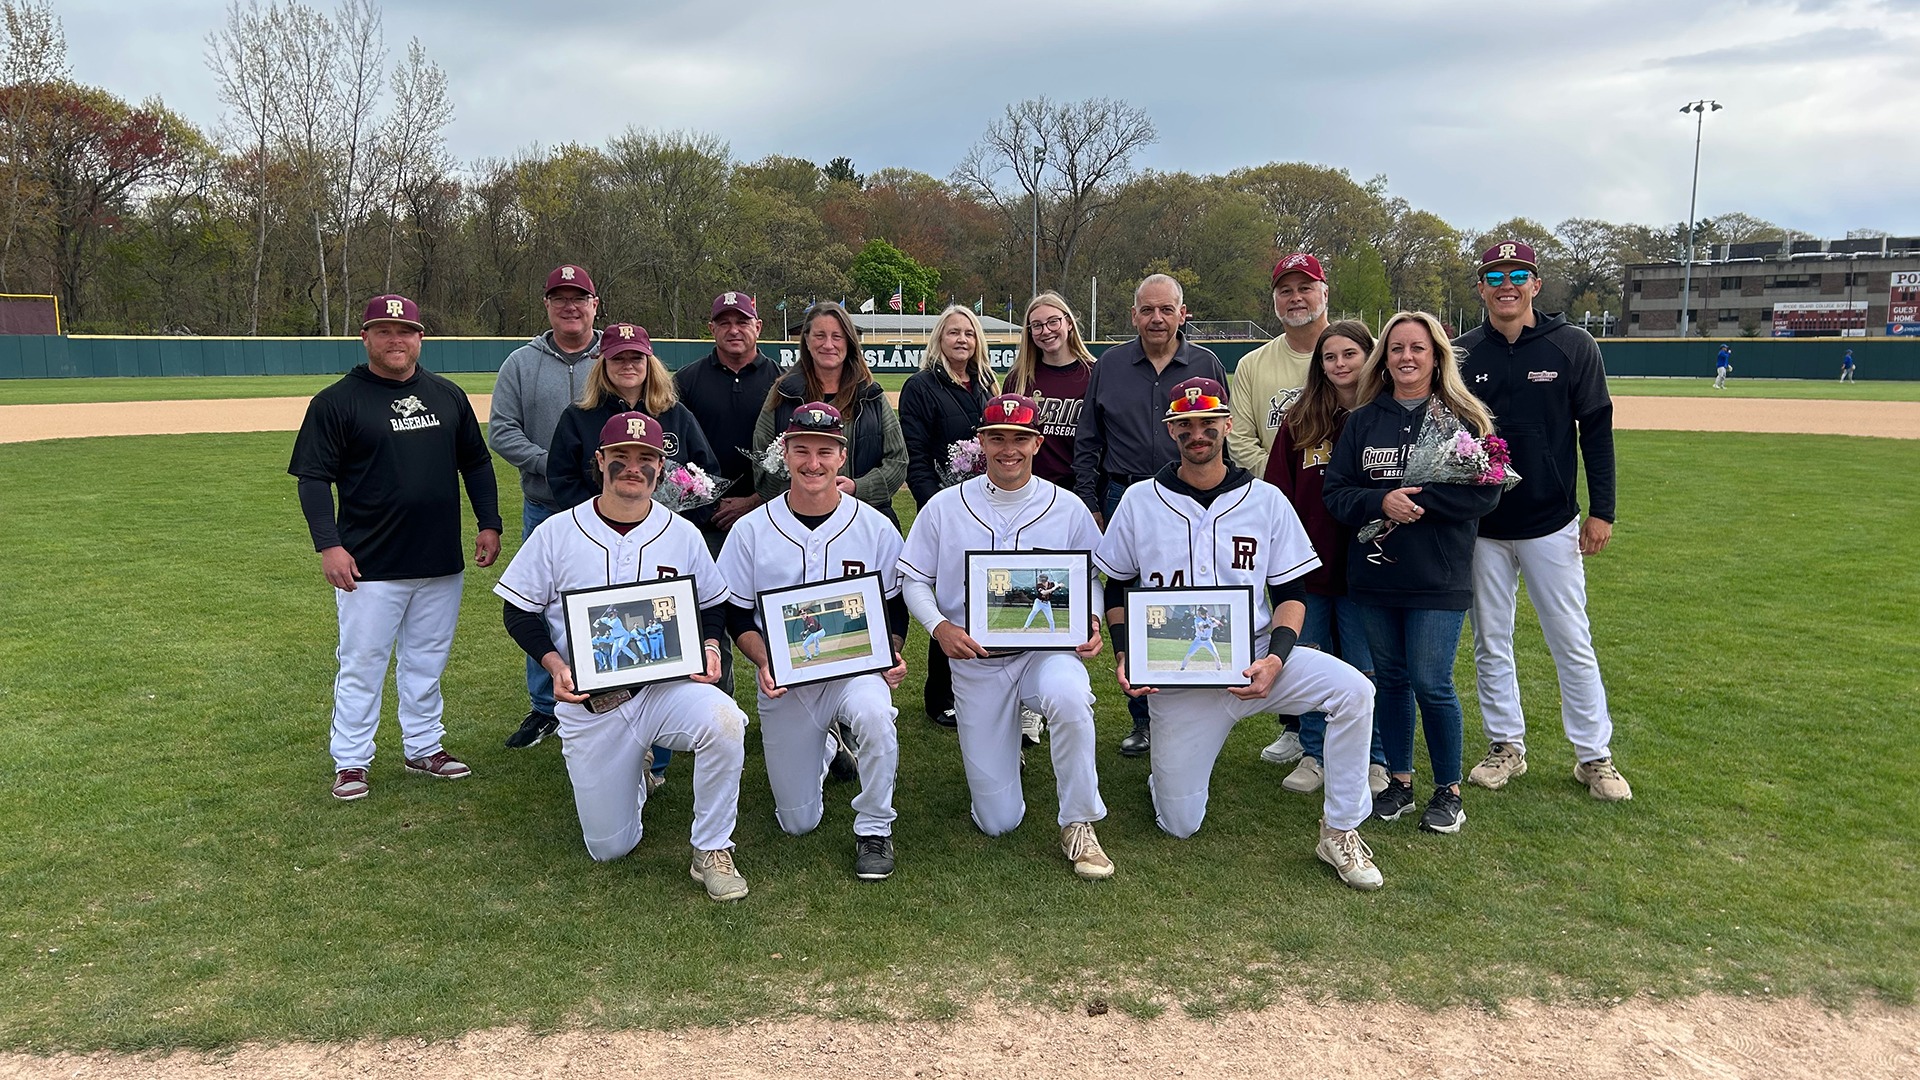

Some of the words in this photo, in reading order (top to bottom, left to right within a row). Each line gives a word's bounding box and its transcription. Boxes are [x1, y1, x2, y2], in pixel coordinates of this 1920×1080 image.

[1896, 273, 1920, 285] PO
[1893, 306, 1918, 314] GUEST
[1893, 314, 1916, 322] HOME
[390, 414, 440, 431] BASEBALL
[1042, 425, 1076, 437] BASEBA
[1363, 448, 1399, 467] RHODE
